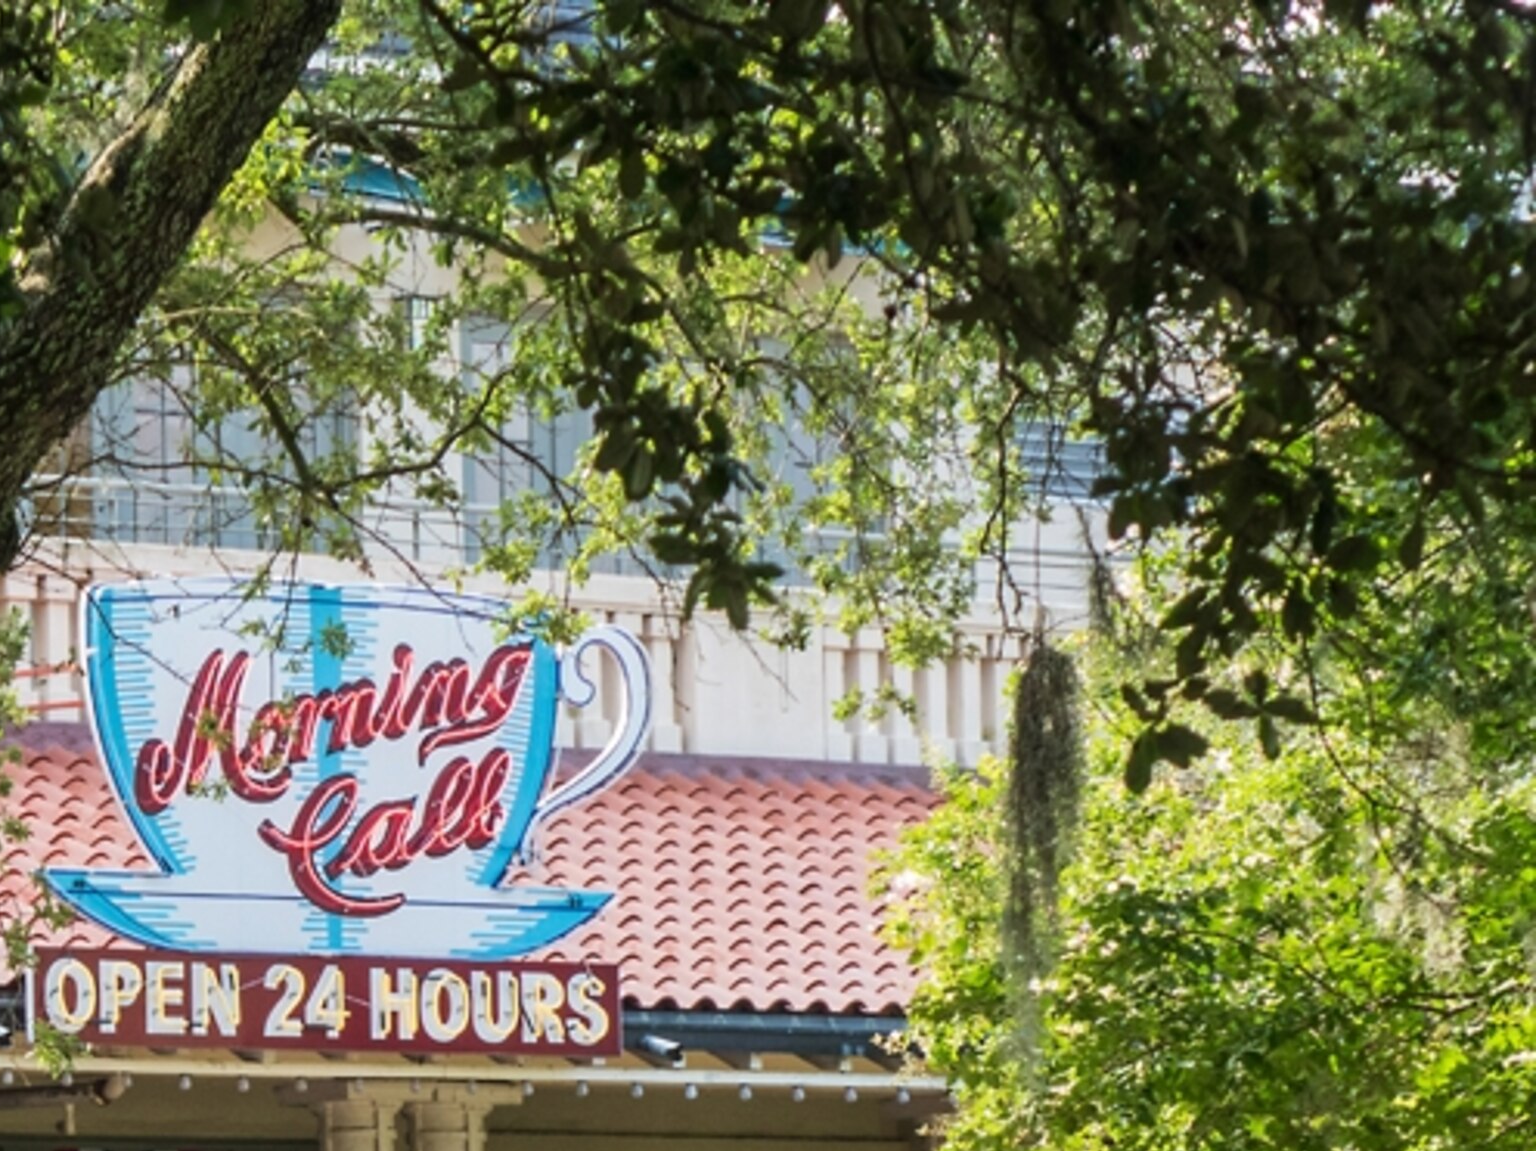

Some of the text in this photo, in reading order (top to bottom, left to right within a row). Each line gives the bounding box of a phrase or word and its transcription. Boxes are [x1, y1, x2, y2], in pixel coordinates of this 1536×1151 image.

[135, 642, 534, 815] Morning
[258, 747, 511, 917] Call
[44, 958, 611, 1047] OPEN 24 HOURS
